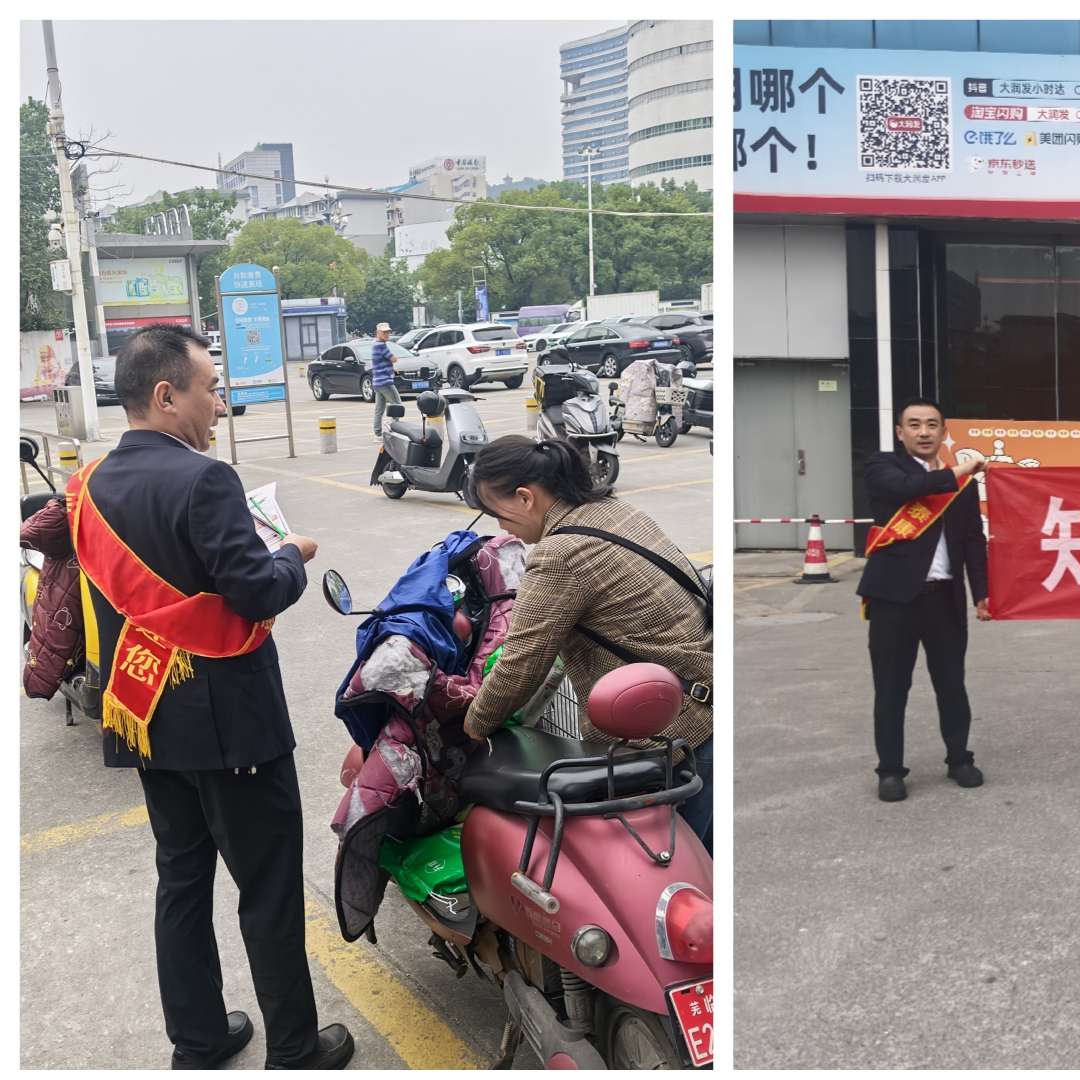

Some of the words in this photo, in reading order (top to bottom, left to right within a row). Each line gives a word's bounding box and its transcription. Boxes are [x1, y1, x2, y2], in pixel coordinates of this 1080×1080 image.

[733, 67, 845, 114] 哪个
[967, 82, 988, 94] 抖音
[1000, 82, 1065, 96] 大润发小时达
[970, 106, 1024, 120] 淘宝闪购
[1037, 109, 1070, 120] 大润发
[979, 130, 1017, 145] 饿了么
[988, 159, 1037, 171] 京东秒送
